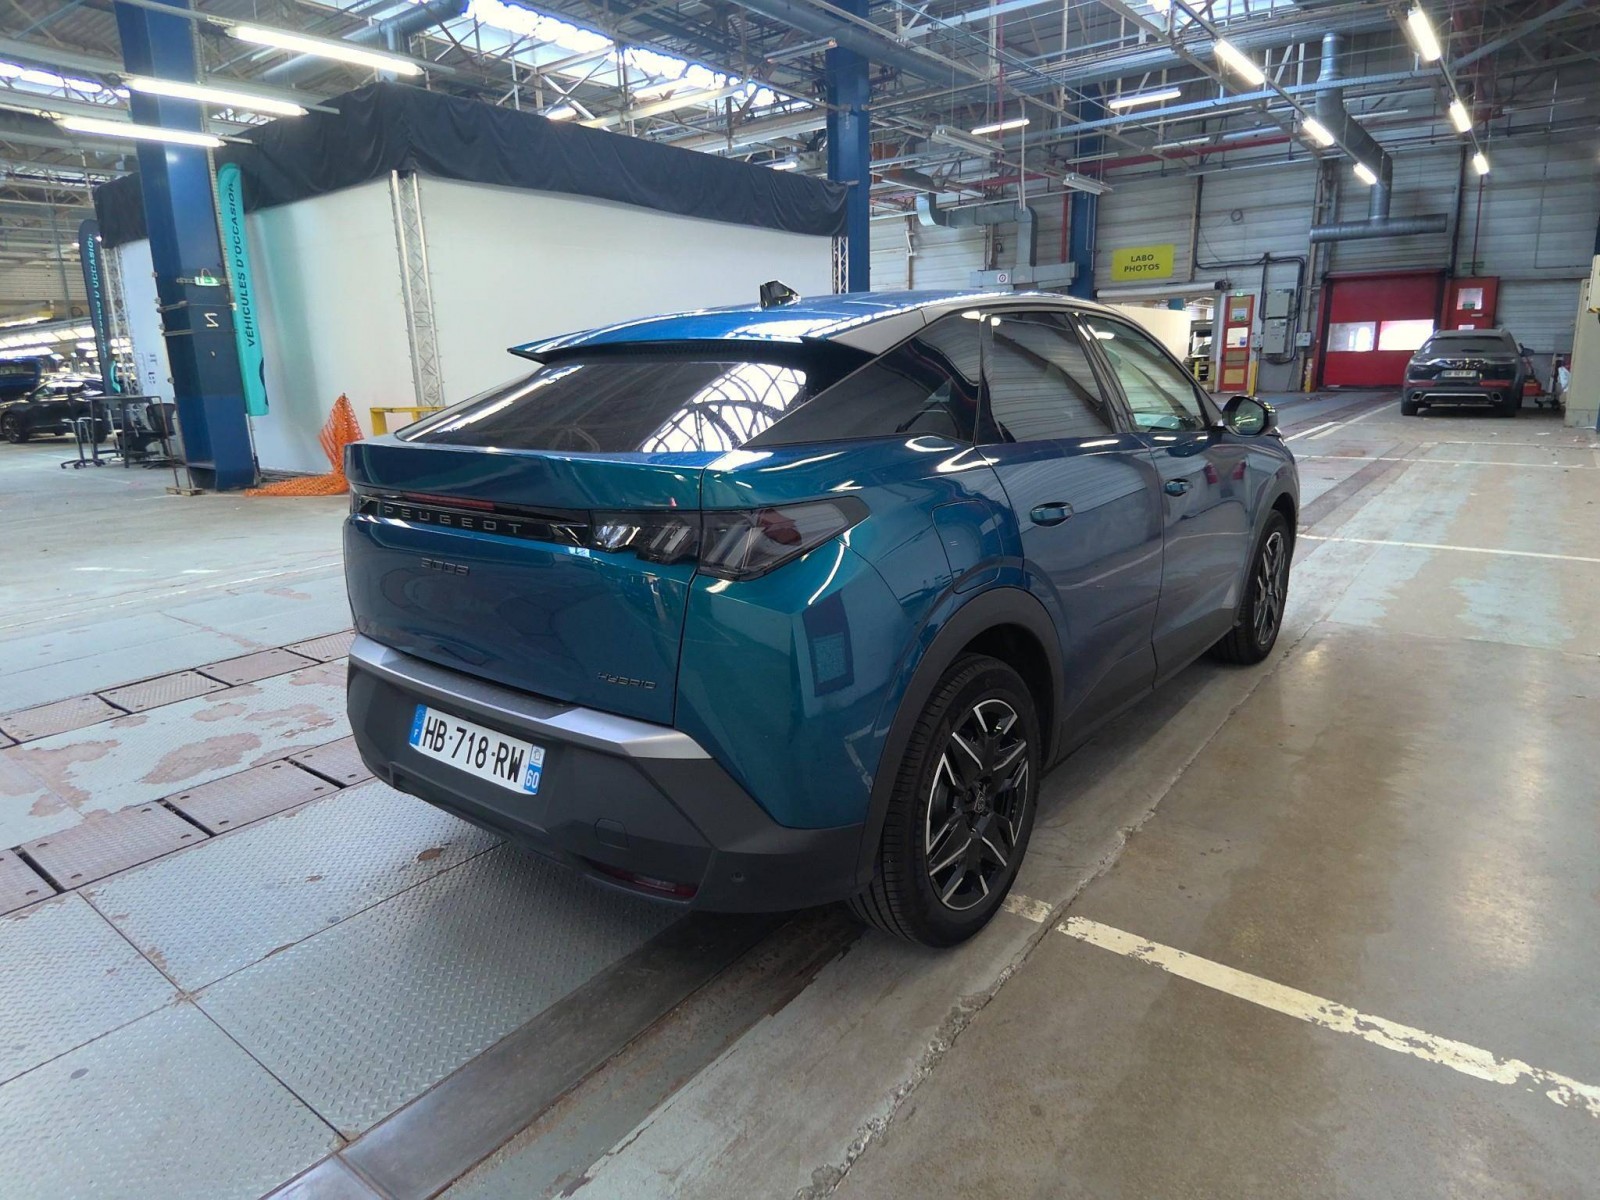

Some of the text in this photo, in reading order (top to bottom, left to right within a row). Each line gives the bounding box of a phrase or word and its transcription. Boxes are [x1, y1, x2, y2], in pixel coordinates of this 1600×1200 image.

[1124, 263, 1160, 272] PHOTOS
[1131, 254, 1154, 262] LABO
[239, 272, 255, 347] VÉHICULES
[383, 505, 522, 534] PEUGEOT
[525, 769, 540, 789] 60
